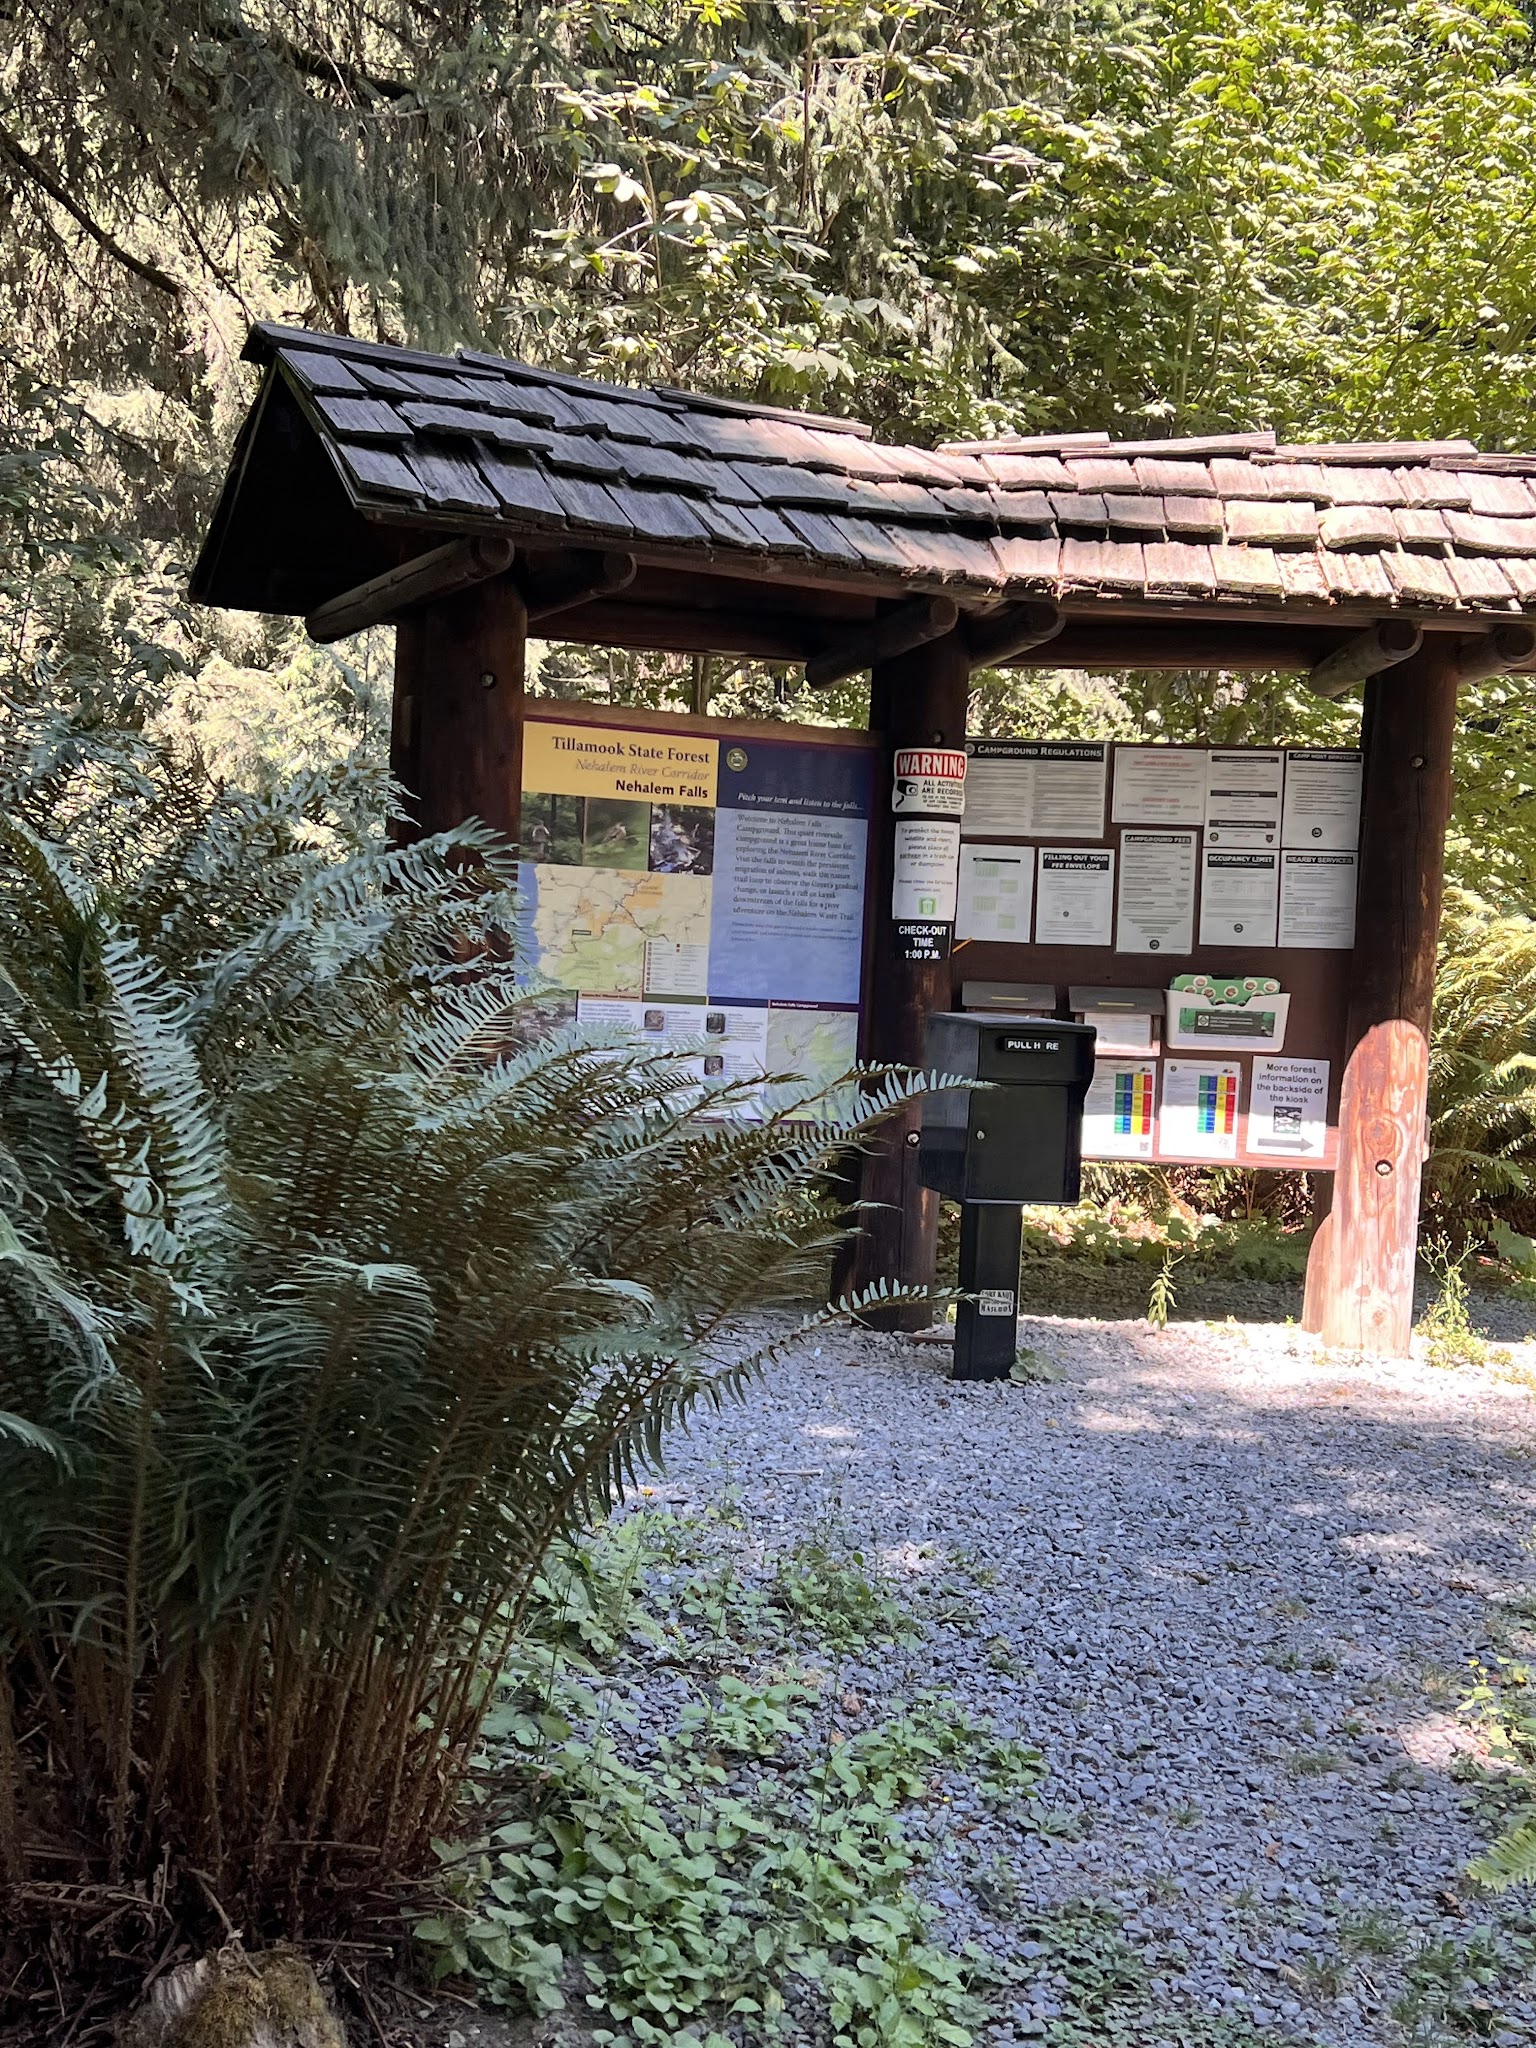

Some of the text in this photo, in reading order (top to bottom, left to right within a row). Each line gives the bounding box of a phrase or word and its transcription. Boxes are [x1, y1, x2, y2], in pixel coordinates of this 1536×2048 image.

[552, 736, 710, 764] Tillamook State Forest
[977, 745, 1102, 757] CAMPGROUND REGULATIONS
[575, 758, 710, 781] Nehalem River Corridor
[900, 754, 964, 777] WARNING
[615, 779, 708, 799] Nehalem Falls
[899, 926, 947, 935] CHECK-OUT
[913, 938, 934, 947] TIME
[905, 950, 922, 959] 1:00
[1008, 1041, 1059, 1050] PULL HRE
[1266, 1063, 1316, 1073] More forest
[1259, 1073, 1308, 1083] information
[1273, 1084, 1312, 1093] backside
[1286, 1095, 1308, 1103] kiosk
